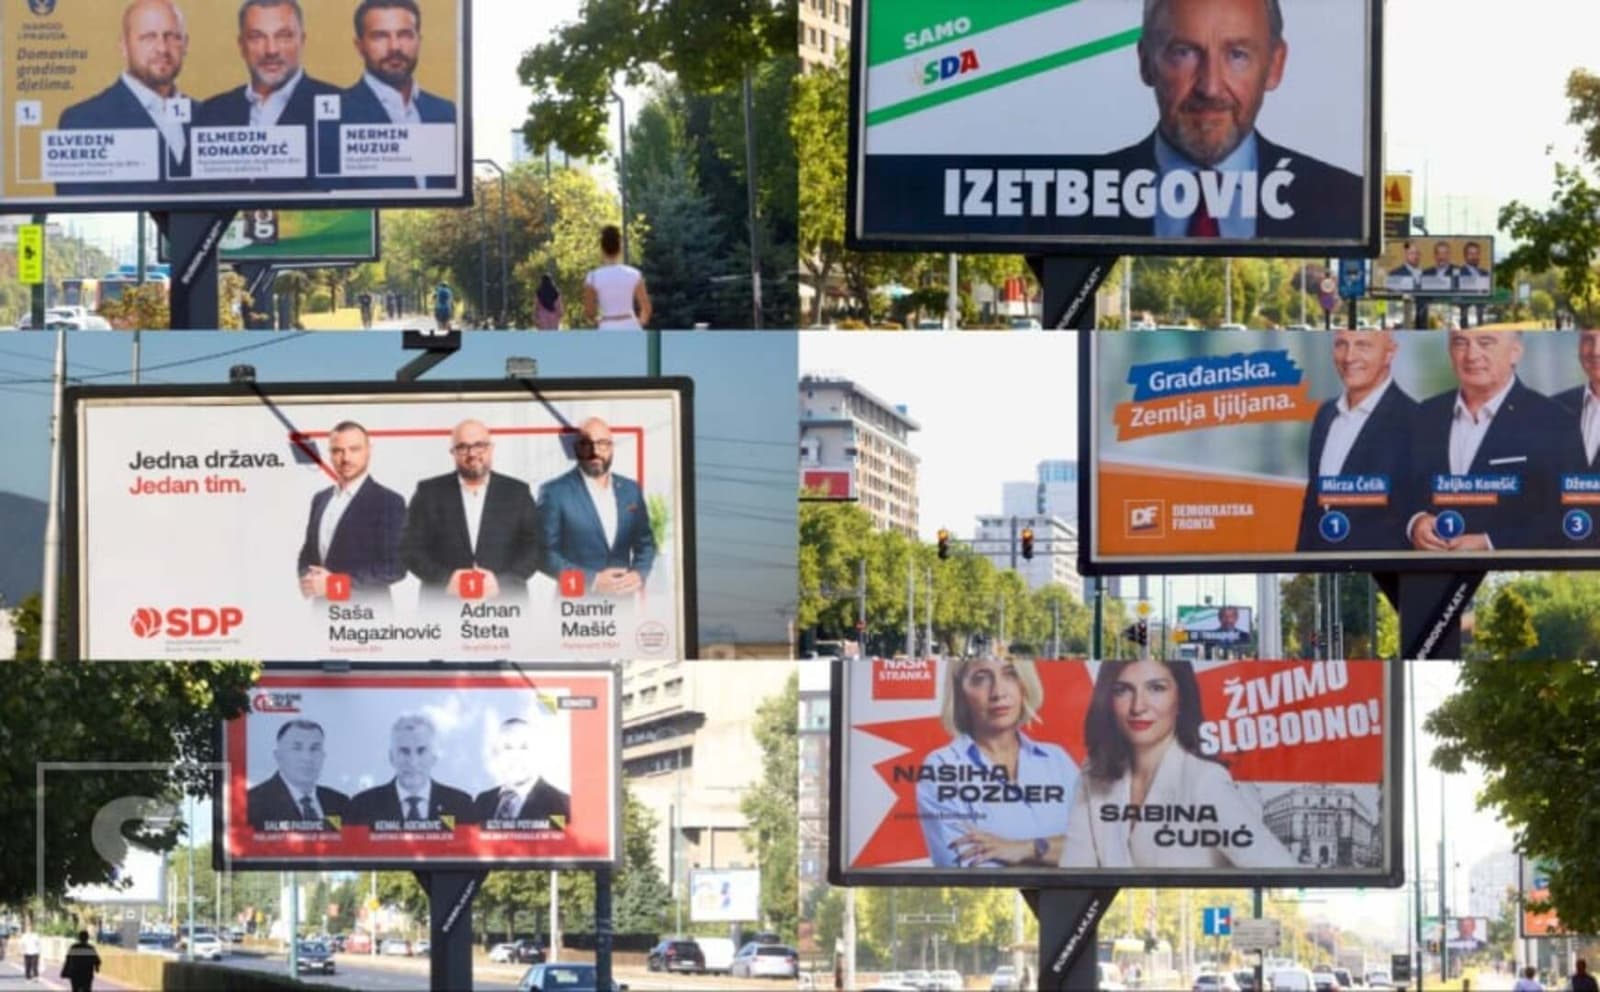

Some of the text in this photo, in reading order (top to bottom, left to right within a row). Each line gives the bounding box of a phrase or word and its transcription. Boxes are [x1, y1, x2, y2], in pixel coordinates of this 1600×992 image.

[904, 16, 972, 50] SAMO
[16, 48, 88, 61] Domovinu
[923, 49, 979, 86] SDA
[22, 106, 36, 120] 1.
[173, 104, 186, 117] 1.
[322, 101, 335, 114] 1.
[47, 134, 115, 147] ELVEDIN
[197, 131, 268, 143] ELMEDIN
[346, 128, 409, 140] NERMIN
[47, 147, 108, 160] OKERIĆ
[197, 141, 289, 157] KONAKOVIĆ
[346, 142, 400, 154] MUZUR
[943, 157, 1296, 220] IZETBEGOVIĆ
[1149, 359, 1277, 392] Građanska.
[1130, 392, 1297, 428] Zemlja ljiljana.
[129, 449, 286, 470] Jedna država.
[129, 475, 247, 495] Jedan tim.
[1131, 506, 1158, 528] DF
[1172, 503, 1255, 517] DEMOKRATSKA
[1172, 518, 1217, 531] FRONTA
[1330, 518, 1340, 535] 1
[1443, 517, 1454, 532] 1
[1571, 516, 1585, 532] 3
[335, 581, 343, 595] 1
[467, 578, 476, 592] 1
[567, 575, 577, 590] 1
[328, 604, 374, 620] Saša
[460, 602, 521, 618] Adnan
[560, 601, 616, 617] Damir
[165, 606, 243, 637] SDP
[460, 620, 510, 639] Šteta
[561, 621, 617, 638] Mašić
[328, 624, 442, 644] Magazinović
[879, 670, 933, 681] STRANKA
[1198, 698, 1382, 757] SLOBODNO!
[893, 763, 1010, 783] NASIHA
[938, 784, 1065, 804] POZDER
[1099, 804, 1219, 823] SABINA
[1153, 824, 1255, 848] ĆUDIĆ
